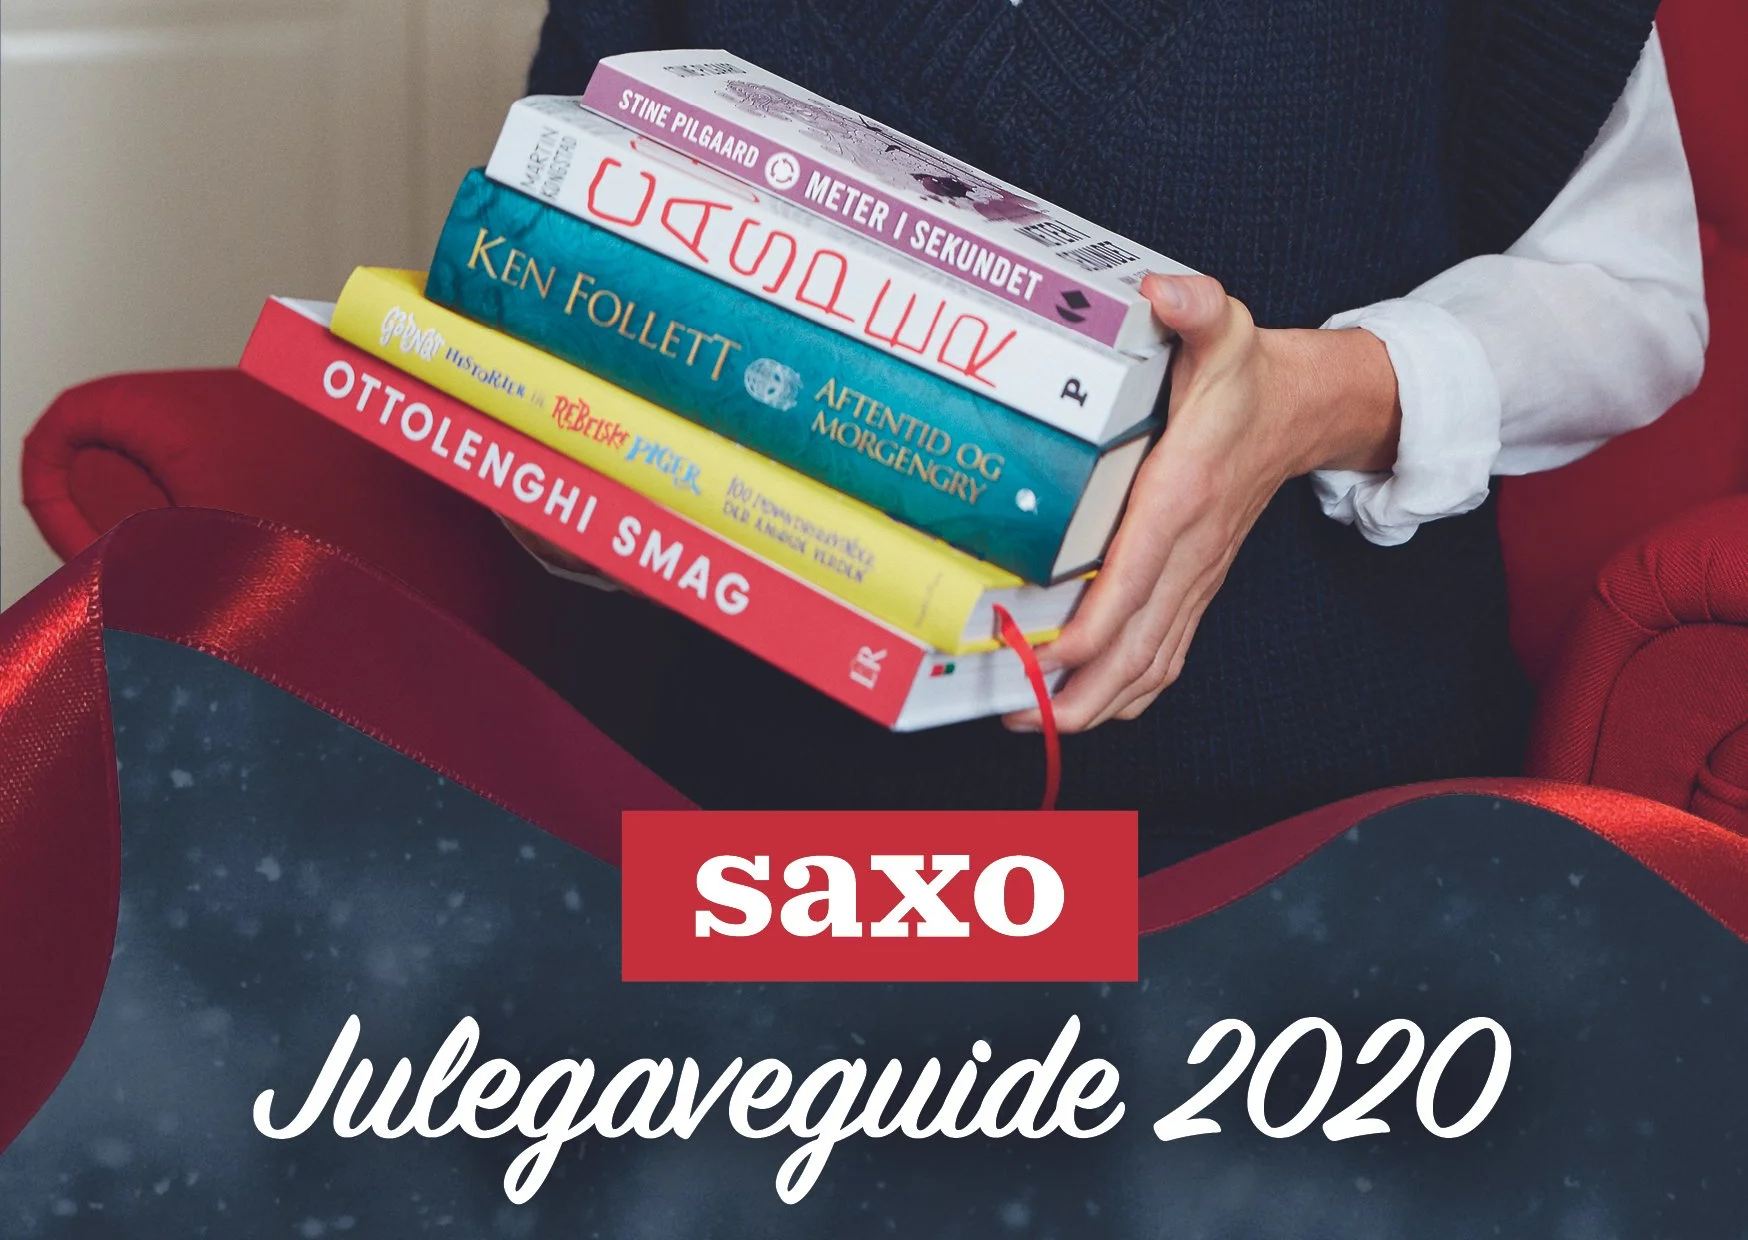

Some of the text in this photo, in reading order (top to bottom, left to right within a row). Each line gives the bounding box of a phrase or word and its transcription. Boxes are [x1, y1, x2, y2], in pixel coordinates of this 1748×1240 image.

[520, 126, 559, 190] MARTIN
[619, 89, 671, 127] STINE
[671, 112, 760, 168] PILGAARD
[804, 170, 893, 232] METER
[893, 213, 908, 240] I
[910, 219, 1043, 301] SEKUNDET
[467, 228, 742, 381] KEN FOLLETT
[587, 157, 1017, 388] CASPER
[322, 360, 598, 534] OTTOLENGHI
[612, 515, 750, 615] SMAG
[624, 434, 701, 496] PIGER
[811, 410, 988, 505] MORGENGRY
[814, 377, 1005, 482] AFTENTID OG
